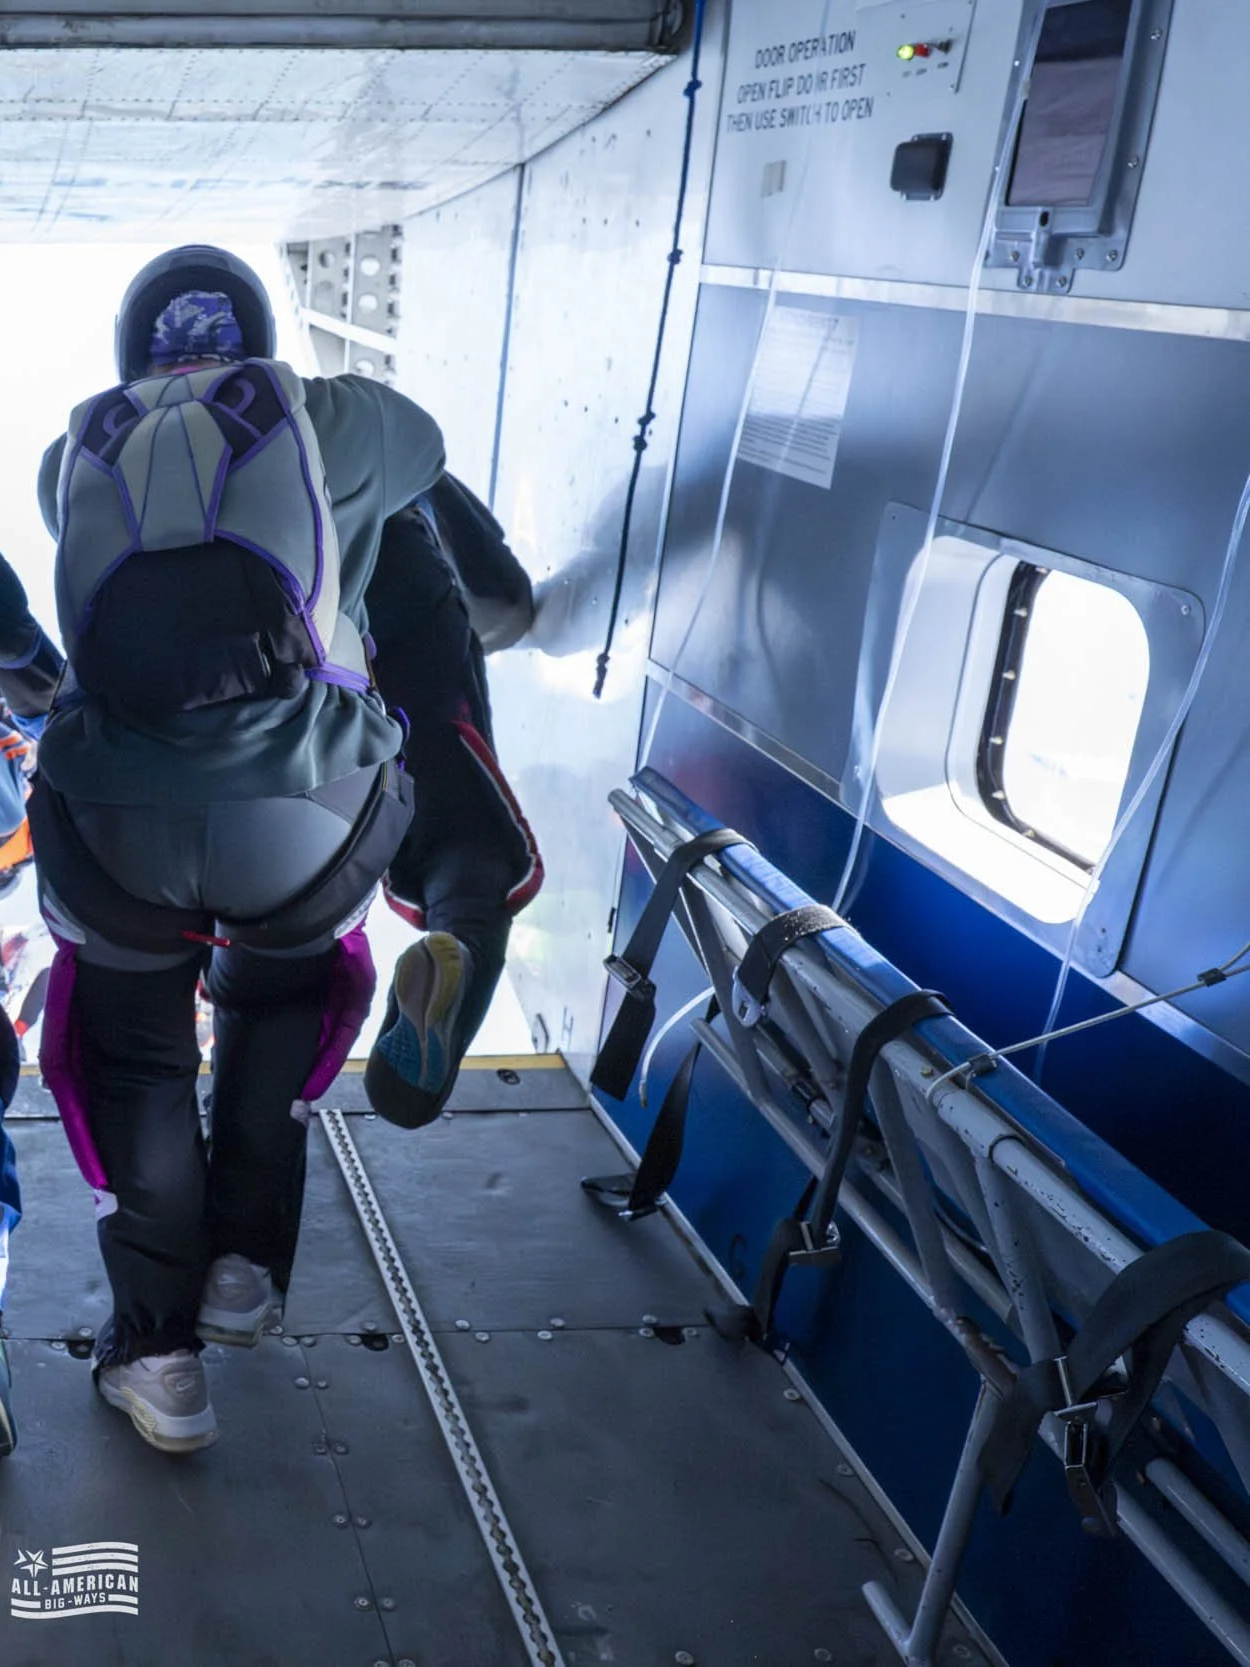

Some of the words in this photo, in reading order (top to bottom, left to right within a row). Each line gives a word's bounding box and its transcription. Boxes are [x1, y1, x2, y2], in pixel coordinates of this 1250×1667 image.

[755, 44, 786, 69] DOOR
[788, 29, 857, 64] OPERATION
[736, 81, 767, 105] OPEN
[768, 76, 794, 99] FLIP
[830, 63, 867, 90] FIRST
[726, 112, 753, 134] THEN
[754, 108, 777, 131] USE
[824, 101, 840, 125] TO
[841, 95, 875, 122] OPEN
